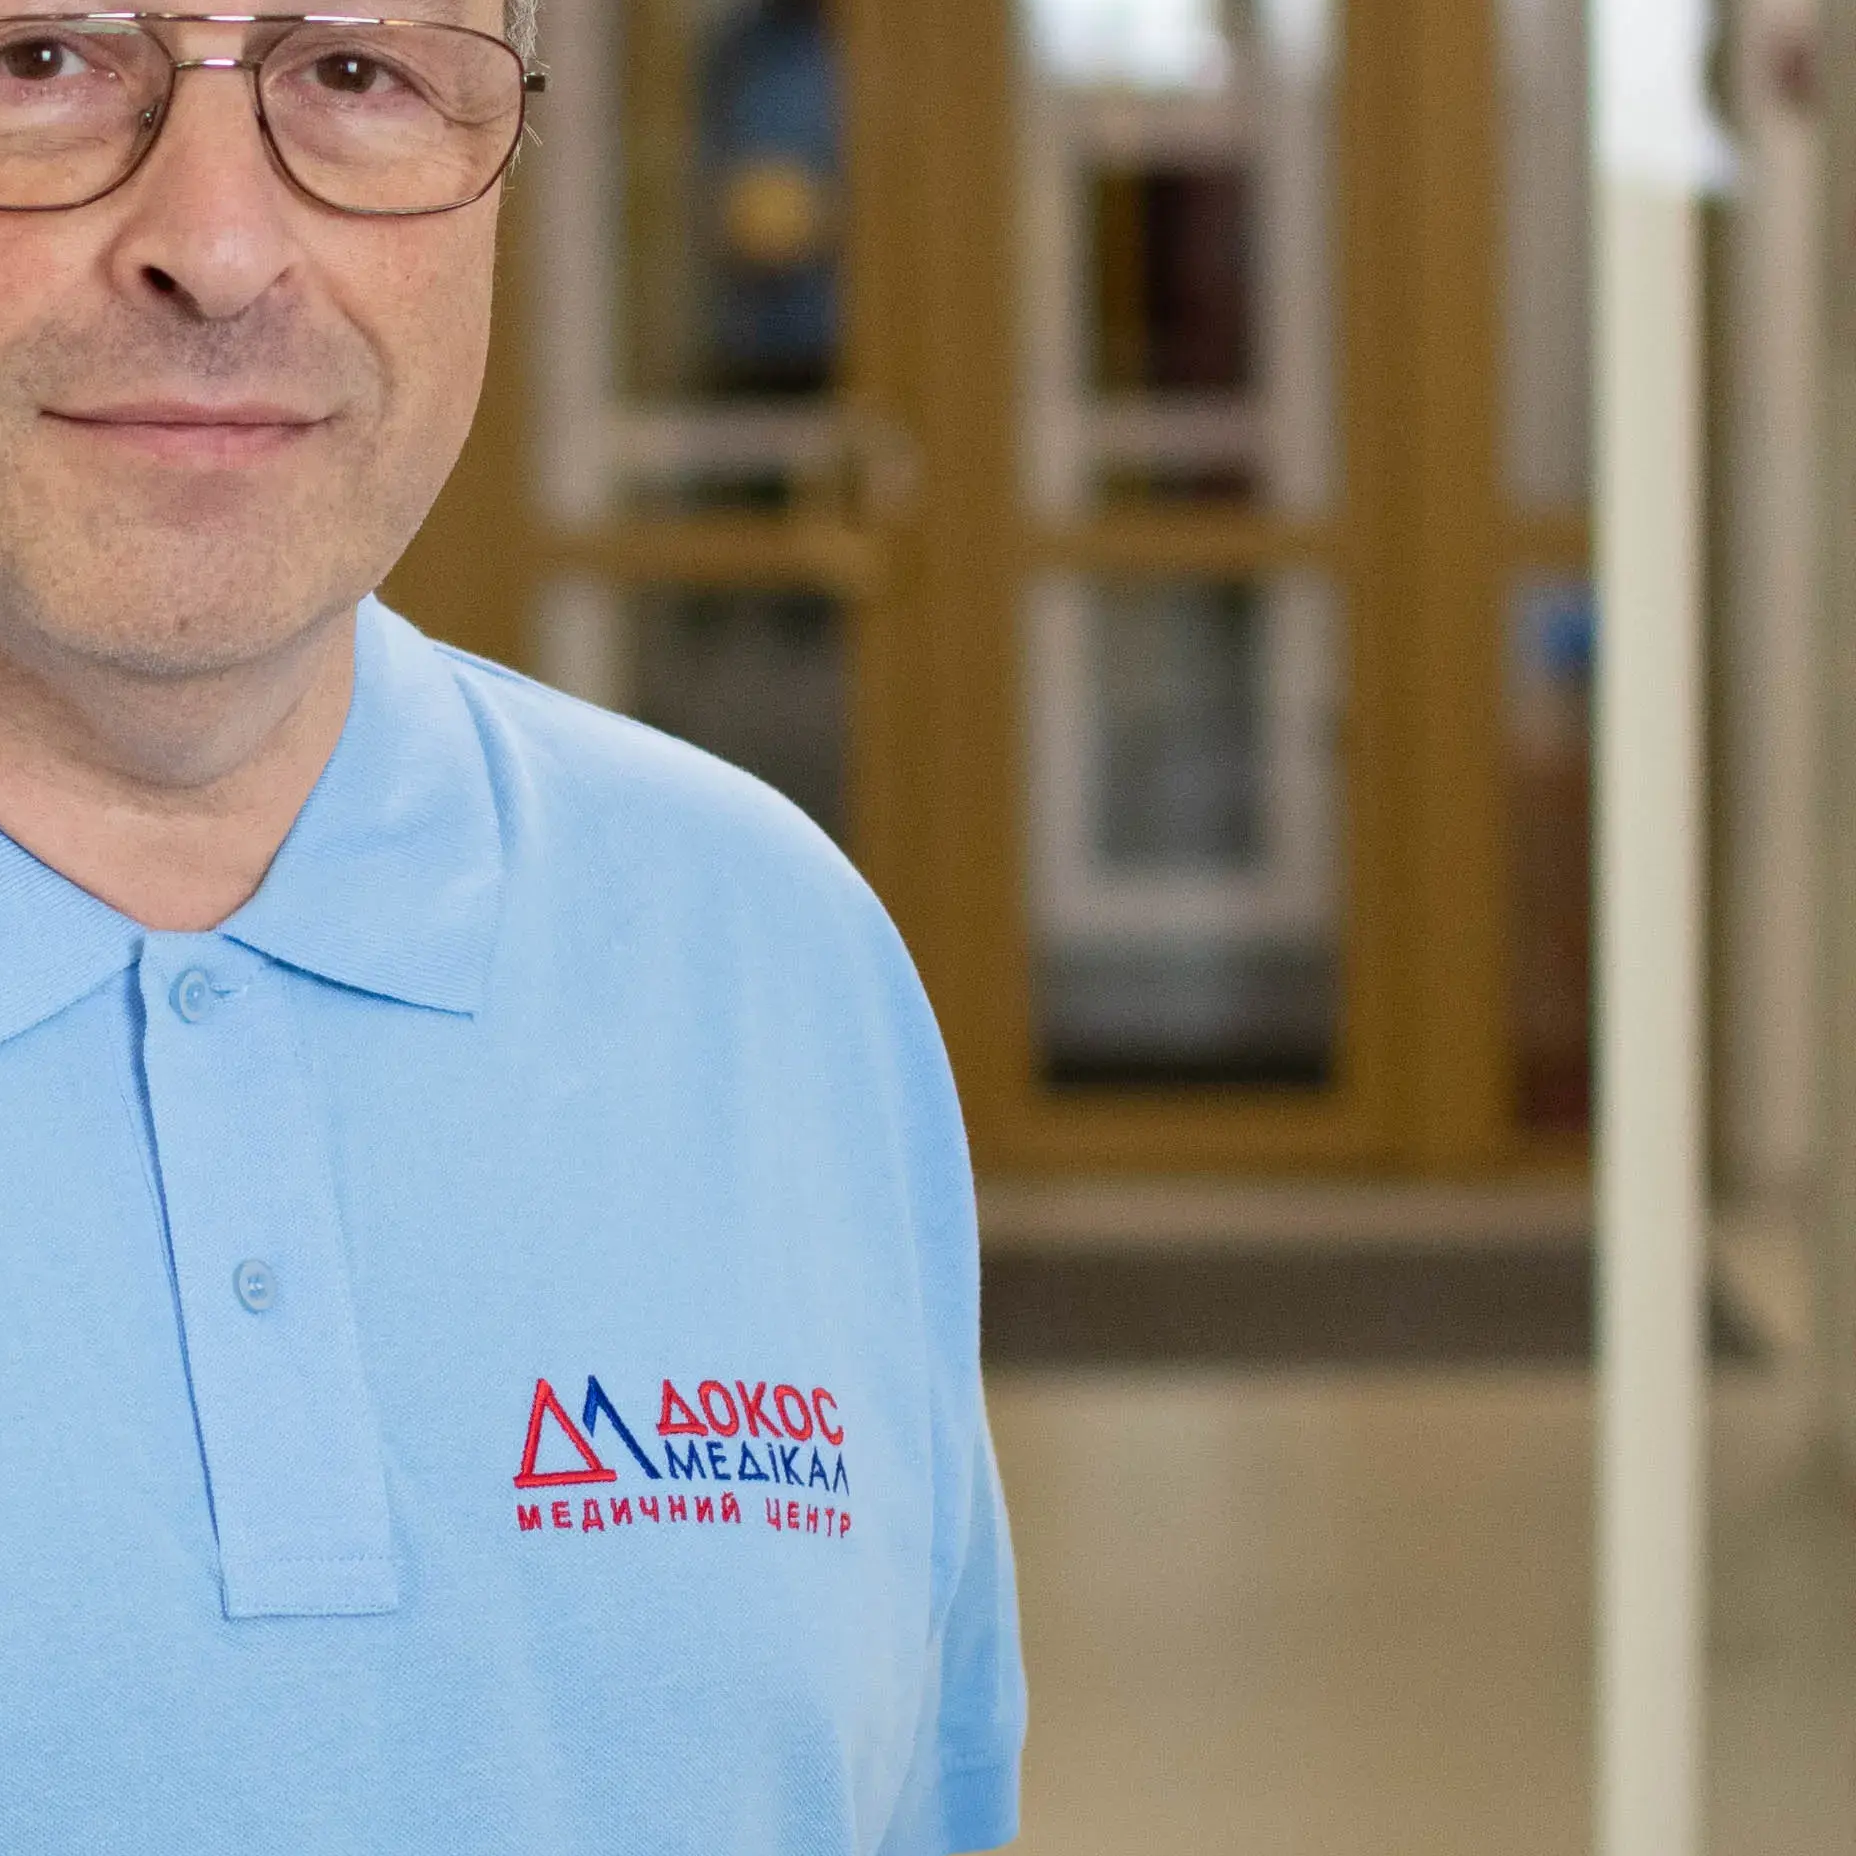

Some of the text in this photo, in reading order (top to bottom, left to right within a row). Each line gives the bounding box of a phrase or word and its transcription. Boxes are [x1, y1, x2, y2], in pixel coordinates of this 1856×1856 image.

[656, 1379, 844, 1446] ДОКОС
[516, 1491, 851, 1538] МЕДИЧНИЙ ЦЕНТР
